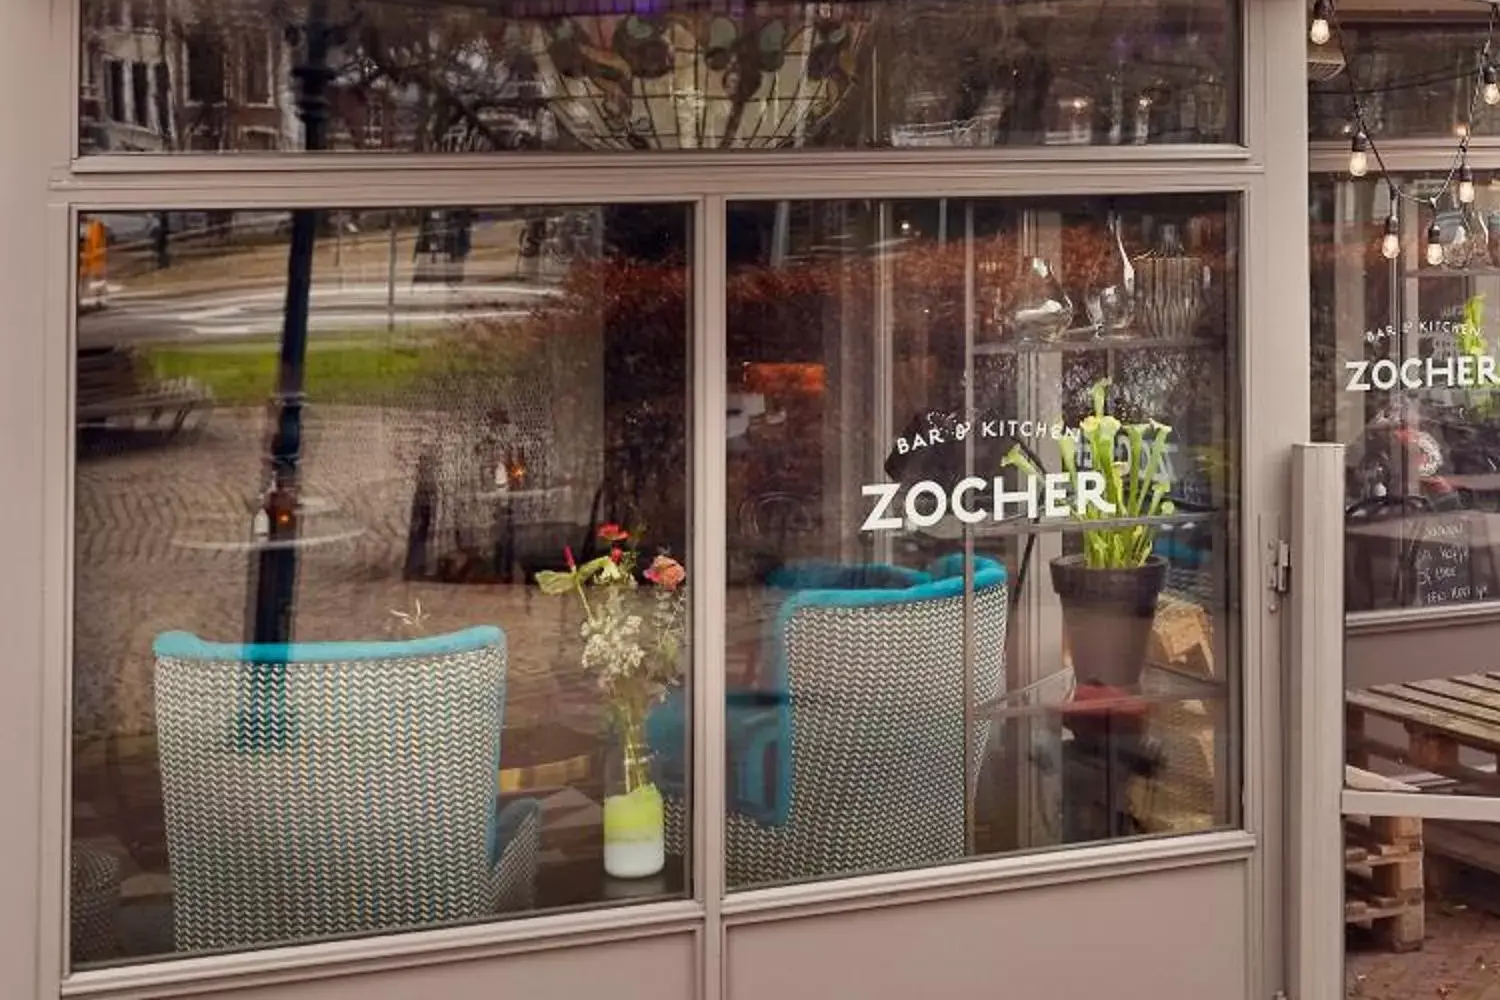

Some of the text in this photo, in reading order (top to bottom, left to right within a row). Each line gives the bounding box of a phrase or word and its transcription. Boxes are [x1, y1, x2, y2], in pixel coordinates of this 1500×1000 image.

[1366, 325, 1397, 342] BAR
[1420, 320, 1482, 337] KITCHEN
[897, 420, 1082, 455] BAR & KITCHEN
[861, 470, 1117, 532] ZOCHER
